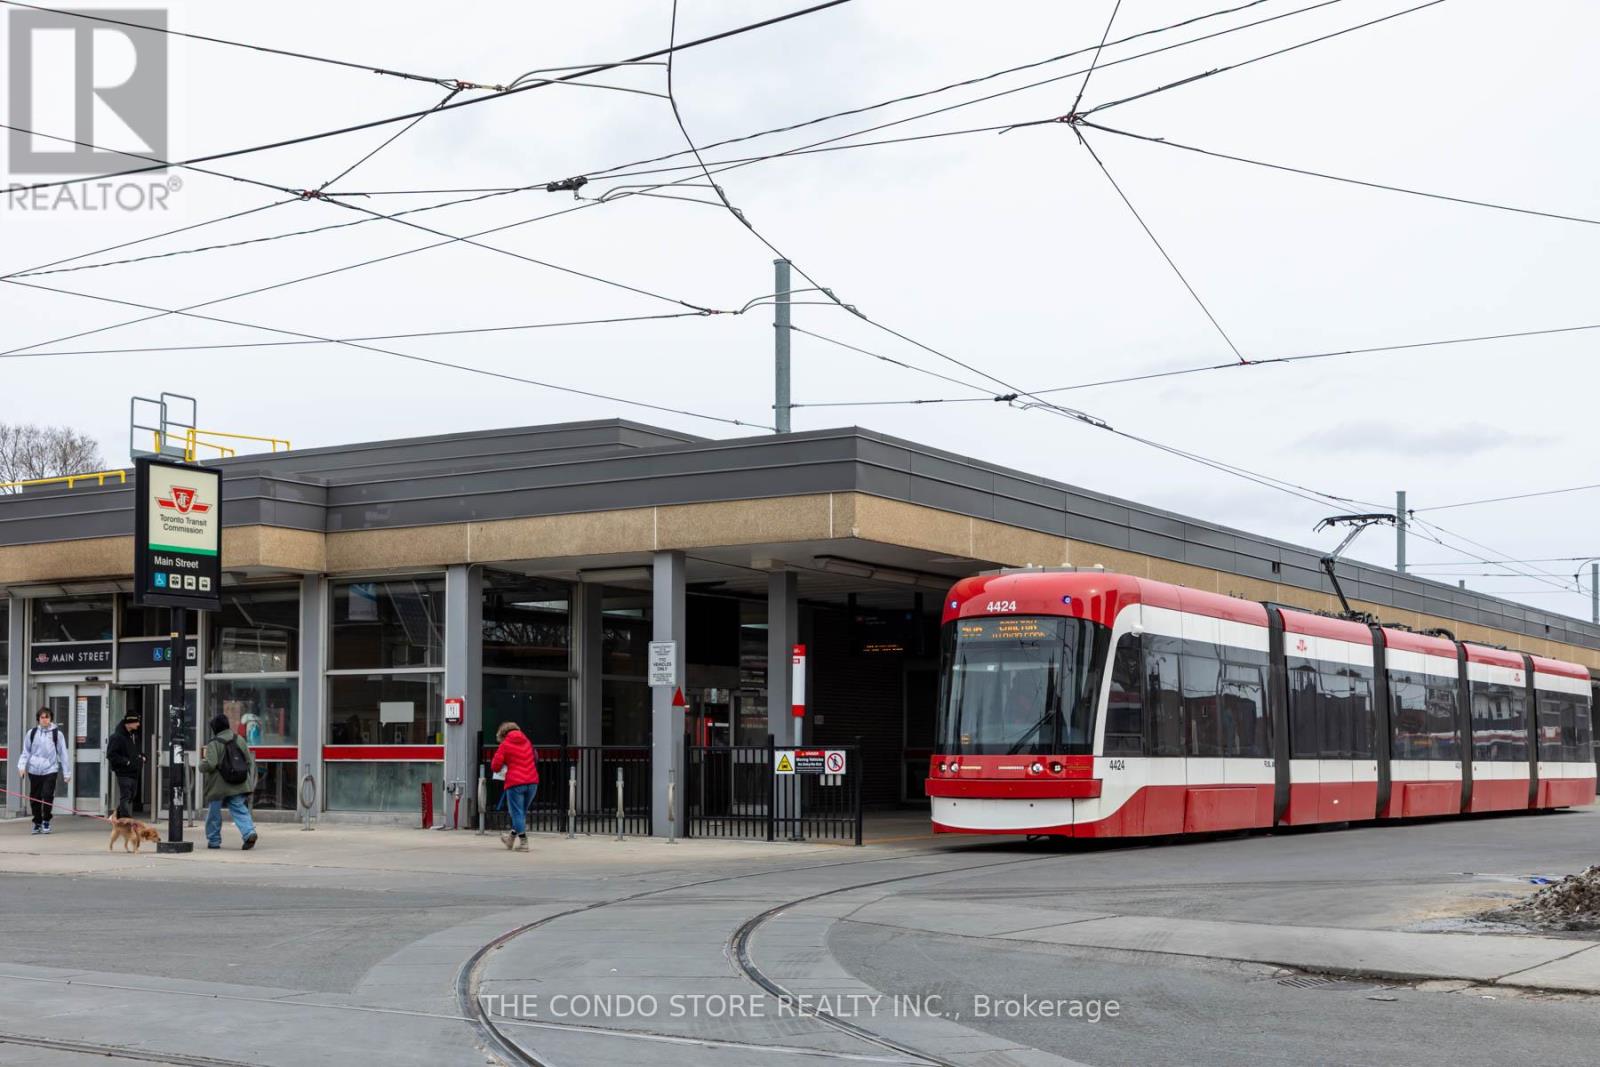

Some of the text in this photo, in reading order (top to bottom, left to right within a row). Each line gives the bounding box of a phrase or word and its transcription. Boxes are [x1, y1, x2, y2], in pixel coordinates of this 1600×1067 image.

[160, 514, 207, 527] Toronto Transit
[163, 523, 203, 534] Commission
[154, 556, 199, 569] Main Street
[986, 600, 1017, 612] 4424
[52, 651, 111, 663] MAIN STREET
[1109, 759, 1125, 771] 4424
